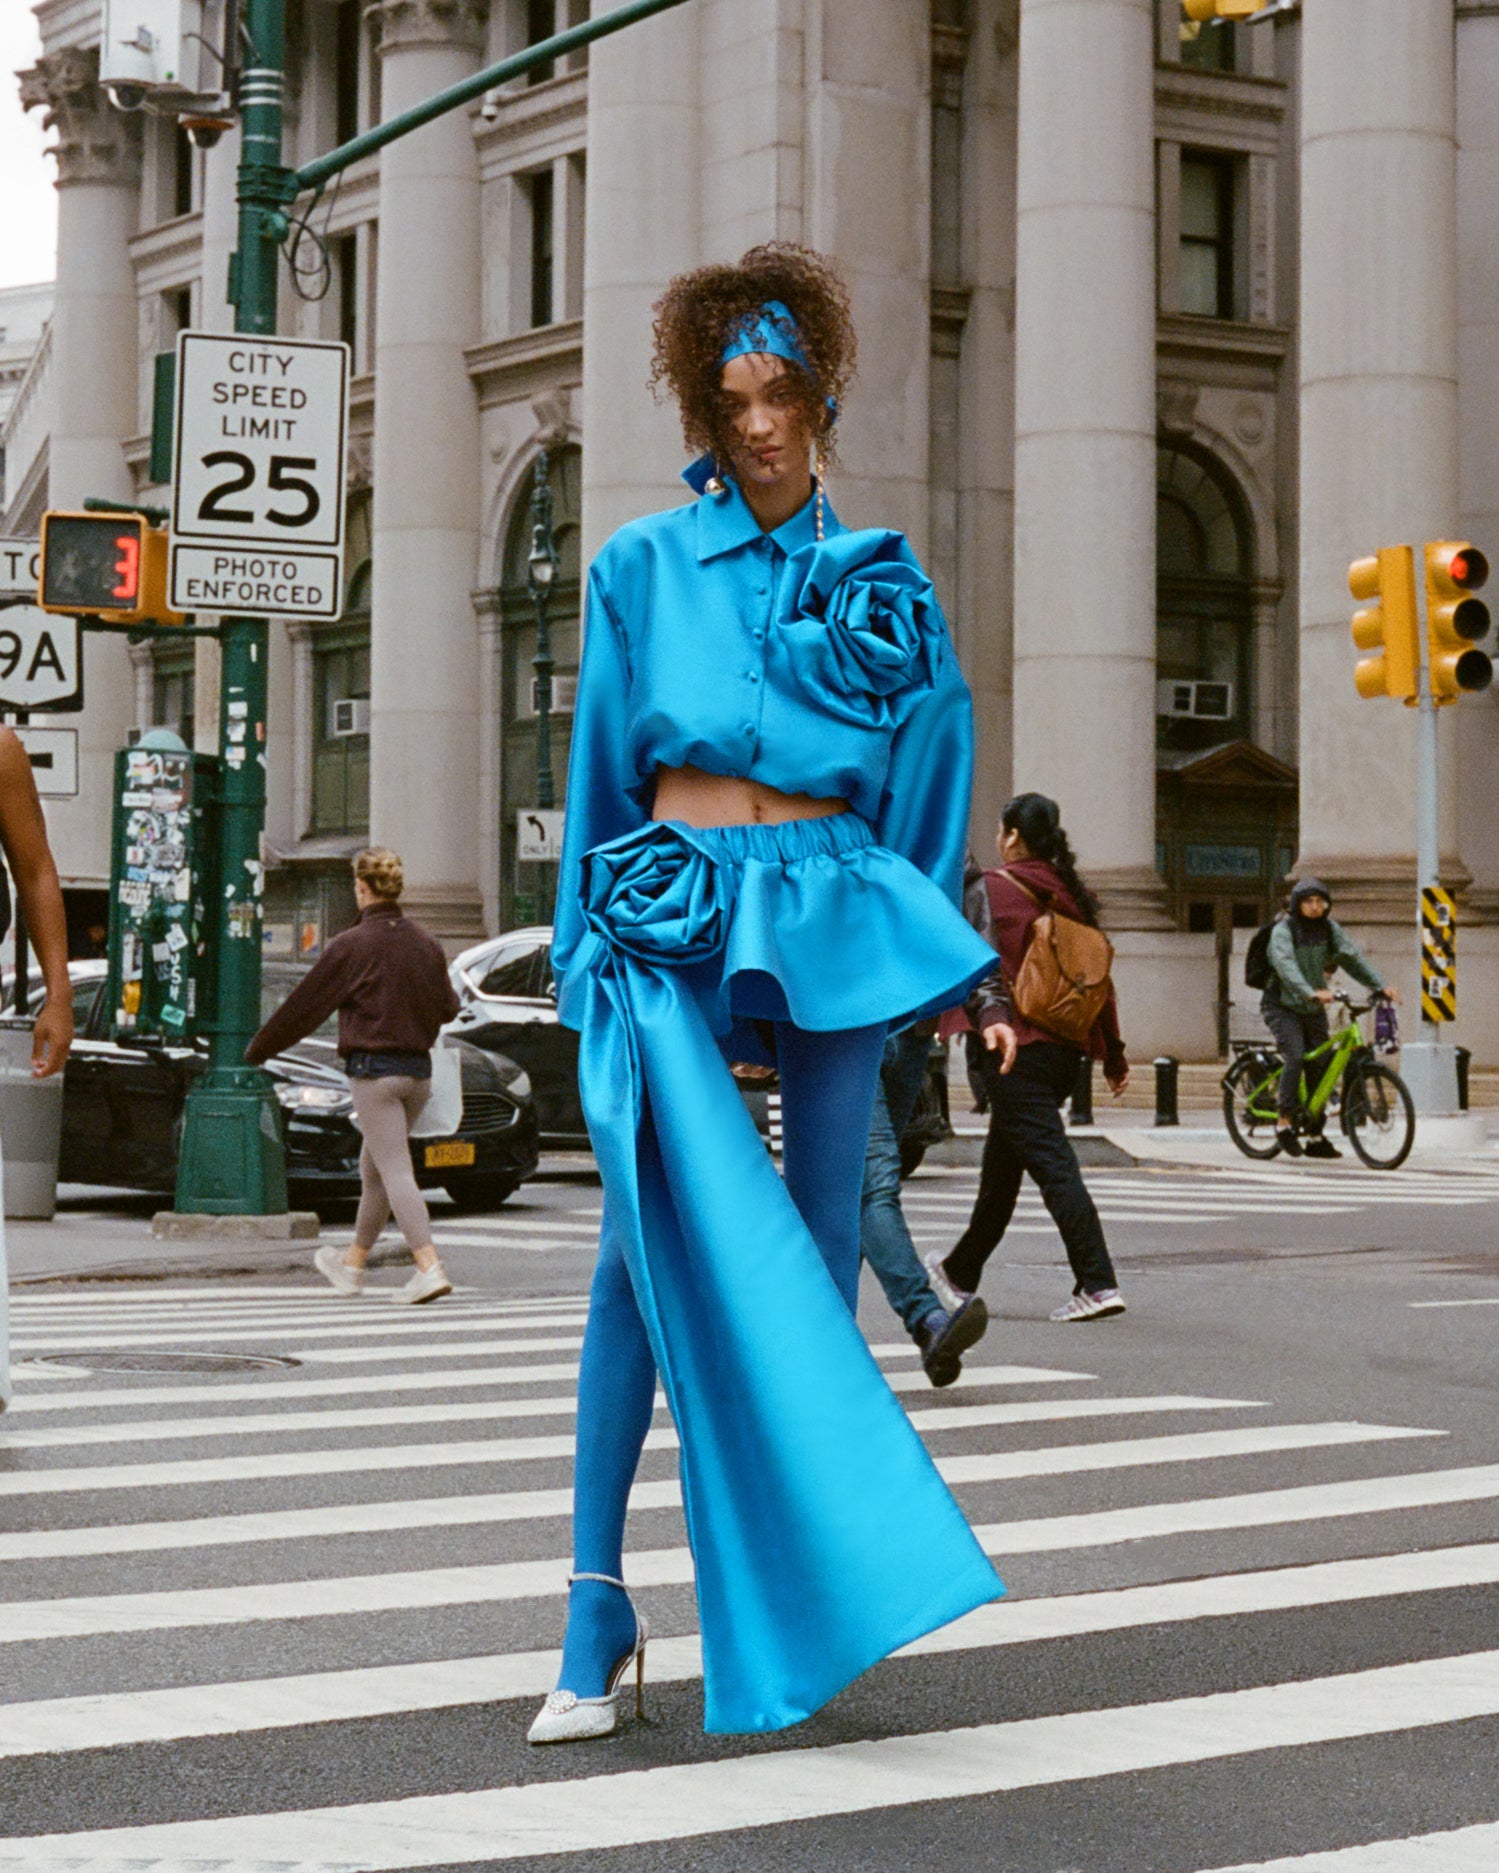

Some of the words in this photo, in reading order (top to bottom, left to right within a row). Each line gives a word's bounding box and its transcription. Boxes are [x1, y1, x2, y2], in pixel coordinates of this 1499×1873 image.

[228, 351, 294, 376] CITY
[212, 382, 307, 410] SPEED
[222, 415, 297, 441] LIMIT
[198, 450, 320, 528] 25
[112, 536, 139, 598] 3
[213, 556, 297, 580] PHOTO
[186, 578, 323, 606] ENFORCED
[0, 629, 67, 682] 9A
